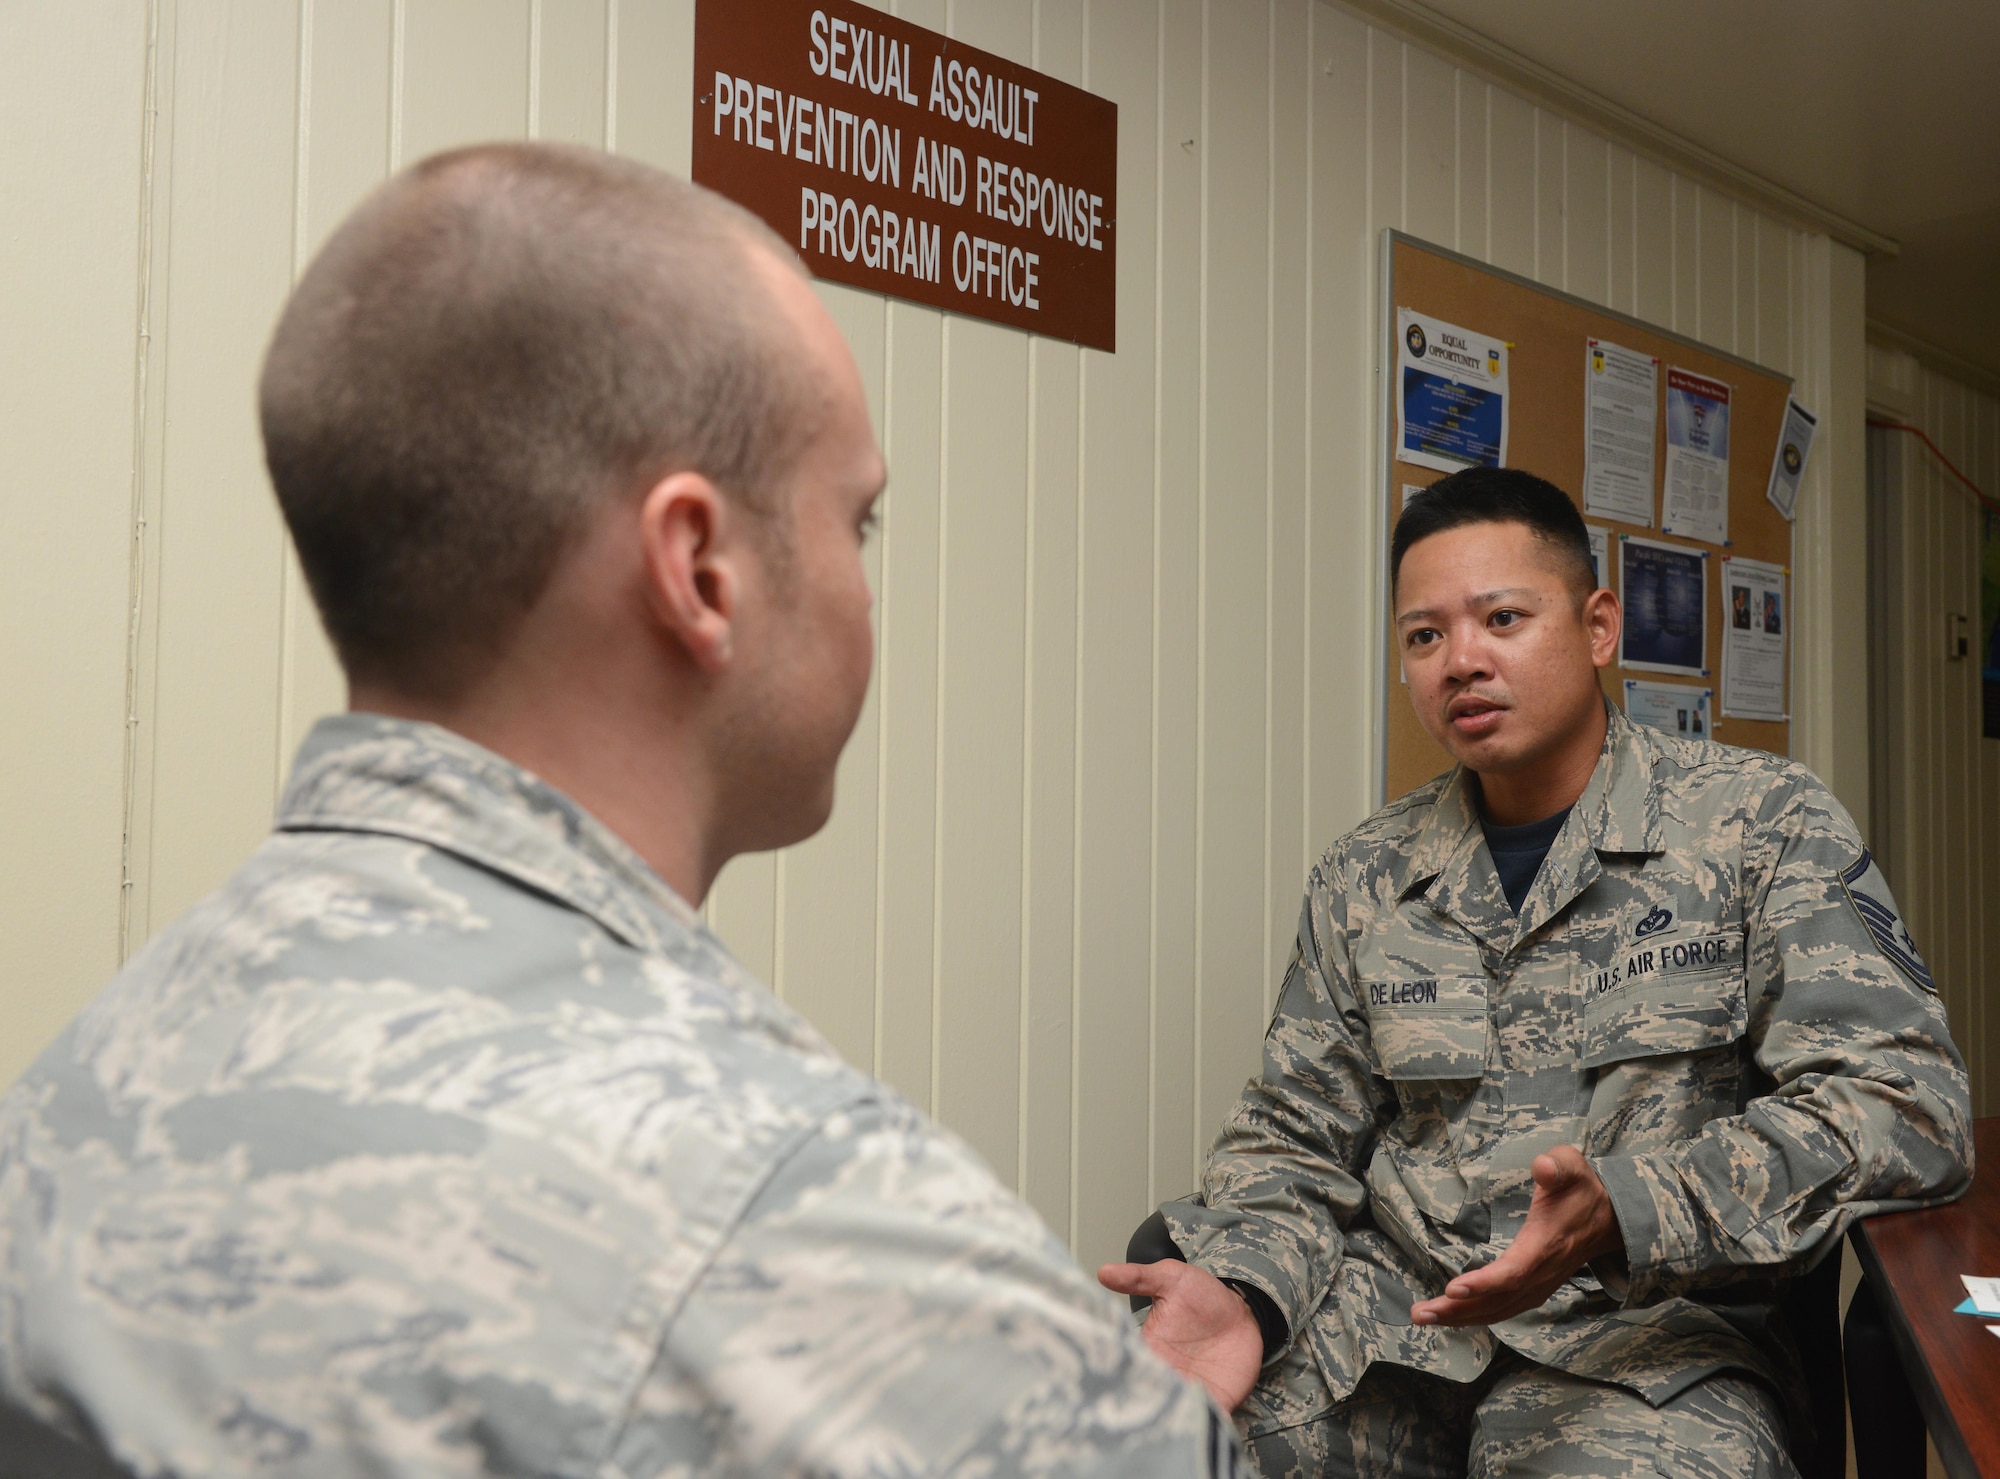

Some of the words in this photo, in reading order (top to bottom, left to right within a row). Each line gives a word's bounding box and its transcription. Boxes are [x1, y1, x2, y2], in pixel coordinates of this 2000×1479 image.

[808, 9, 919, 106] SEXUAL
[928, 55, 1039, 146] ASSAULT
[713, 71, 901, 188] PREVENTION
[911, 136, 967, 207] AND
[976, 156, 1103, 251] RESPONSE
[801, 187, 941, 284] PROGRAM
[952, 231, 1040, 310] OFFICE
[1428, 345, 1481, 370] OPPORTUNITY
[1441, 333, 1468, 351] EQUAL
[1391, 980, 1438, 1004] LEON
[1598, 967, 1622, 994] U.S.
[1626, 952, 1654, 979] AIR
[1660, 939, 1727, 970] FORCE
